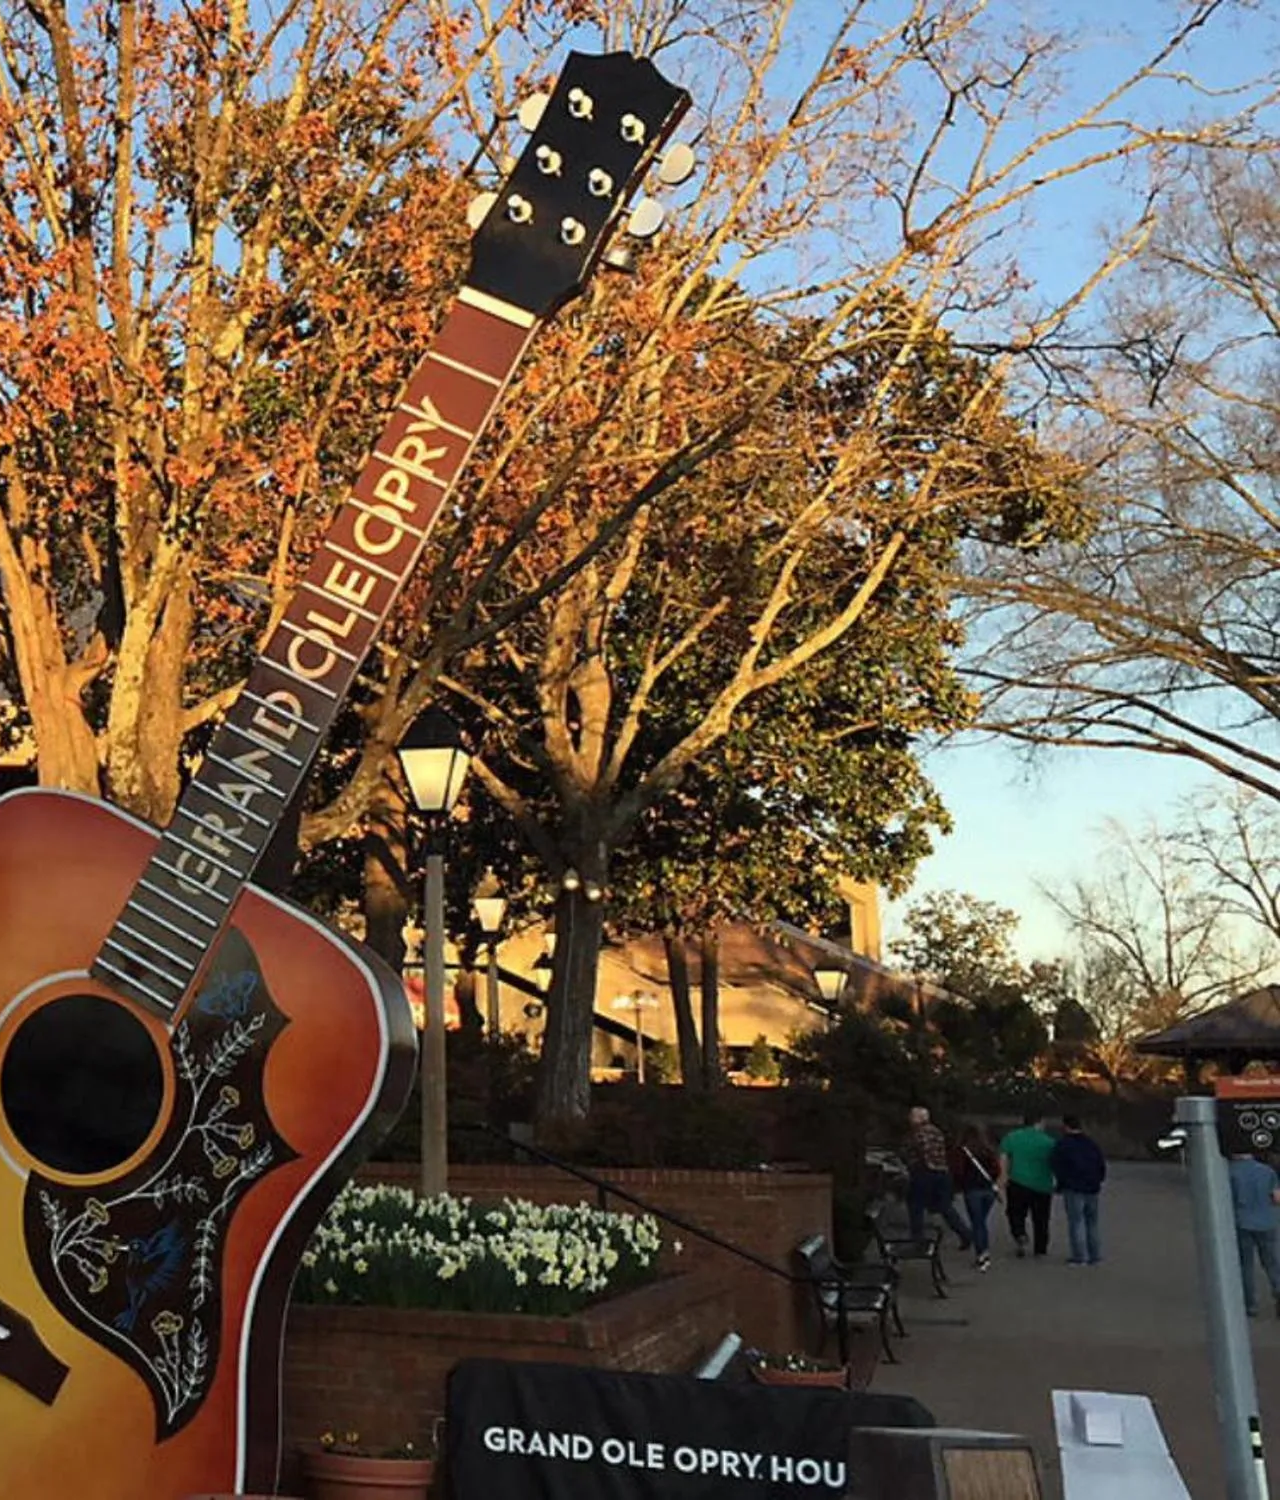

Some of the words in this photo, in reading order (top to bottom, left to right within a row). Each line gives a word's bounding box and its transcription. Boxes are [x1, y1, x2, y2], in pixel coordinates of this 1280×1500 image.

[175, 690, 303, 895] GRAND
[286, 559, 378, 680] OLE
[352, 394, 449, 556] OPRY
[482, 1425, 594, 1461] GRAND
[601, 1438, 666, 1470] OLE
[770, 1455, 847, 1488] HOU
